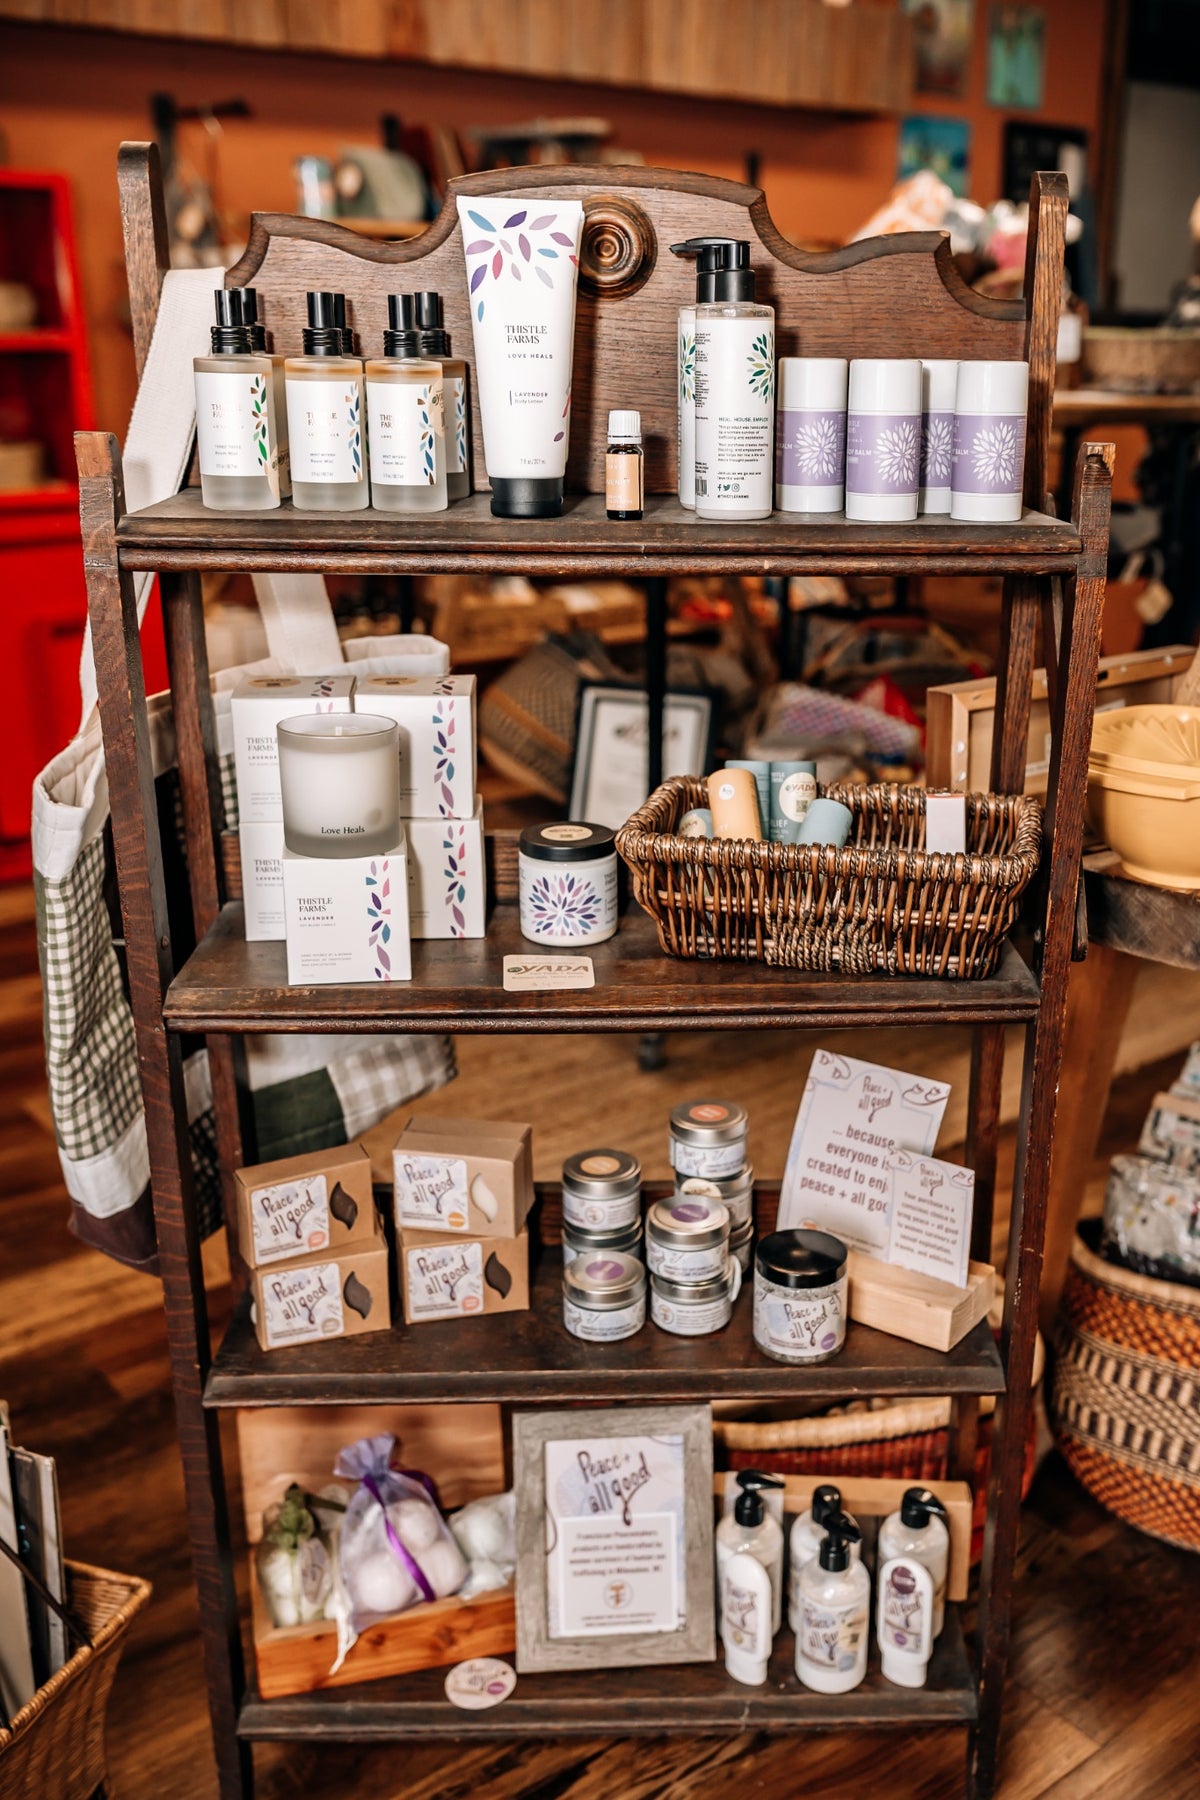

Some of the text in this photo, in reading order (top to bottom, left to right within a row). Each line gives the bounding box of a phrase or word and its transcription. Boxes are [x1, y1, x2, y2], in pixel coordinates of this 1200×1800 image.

[505, 325, 547, 334] THISTLE
[507, 335, 539, 344] FARMS
[321, 825, 365, 834] Love Heals
[297, 897, 333, 905] THISTLE
[862, 1076, 881, 1094] Peace
[858, 1091, 893, 1123] all good
[846, 1125, 895, 1149] because
[826, 1142, 878, 1167] everyone
[403, 1164, 434, 1183] Peace
[807, 1157, 851, 1179] created
[854, 1170, 864, 1184] to
[412, 1170, 455, 1214] all good
[800, 1176, 835, 1198] peace
[840, 1189, 846, 1198] +
[851, 1191, 866, 1205] all
[918, 1196, 943, 1208] purchase
[261, 1195, 292, 1218] Peace
[271, 1190, 315, 1239] all good
[930, 1211, 948, 1221] choice
[897, 1210, 911, 1221] bring
[913, 1215, 929, 1226] peace
[945, 1226, 959, 1236] good
[417, 1257, 448, 1277] Peace
[426, 1255, 470, 1301] all good
[272, 1282, 306, 1303] Peace
[282, 1277, 328, 1325] all good
[784, 1304, 810, 1322] Peace
[790, 1305, 828, 1346] all good
[577, 1451, 622, 1484] Peace
[589, 1452, 651, 1526] all good
